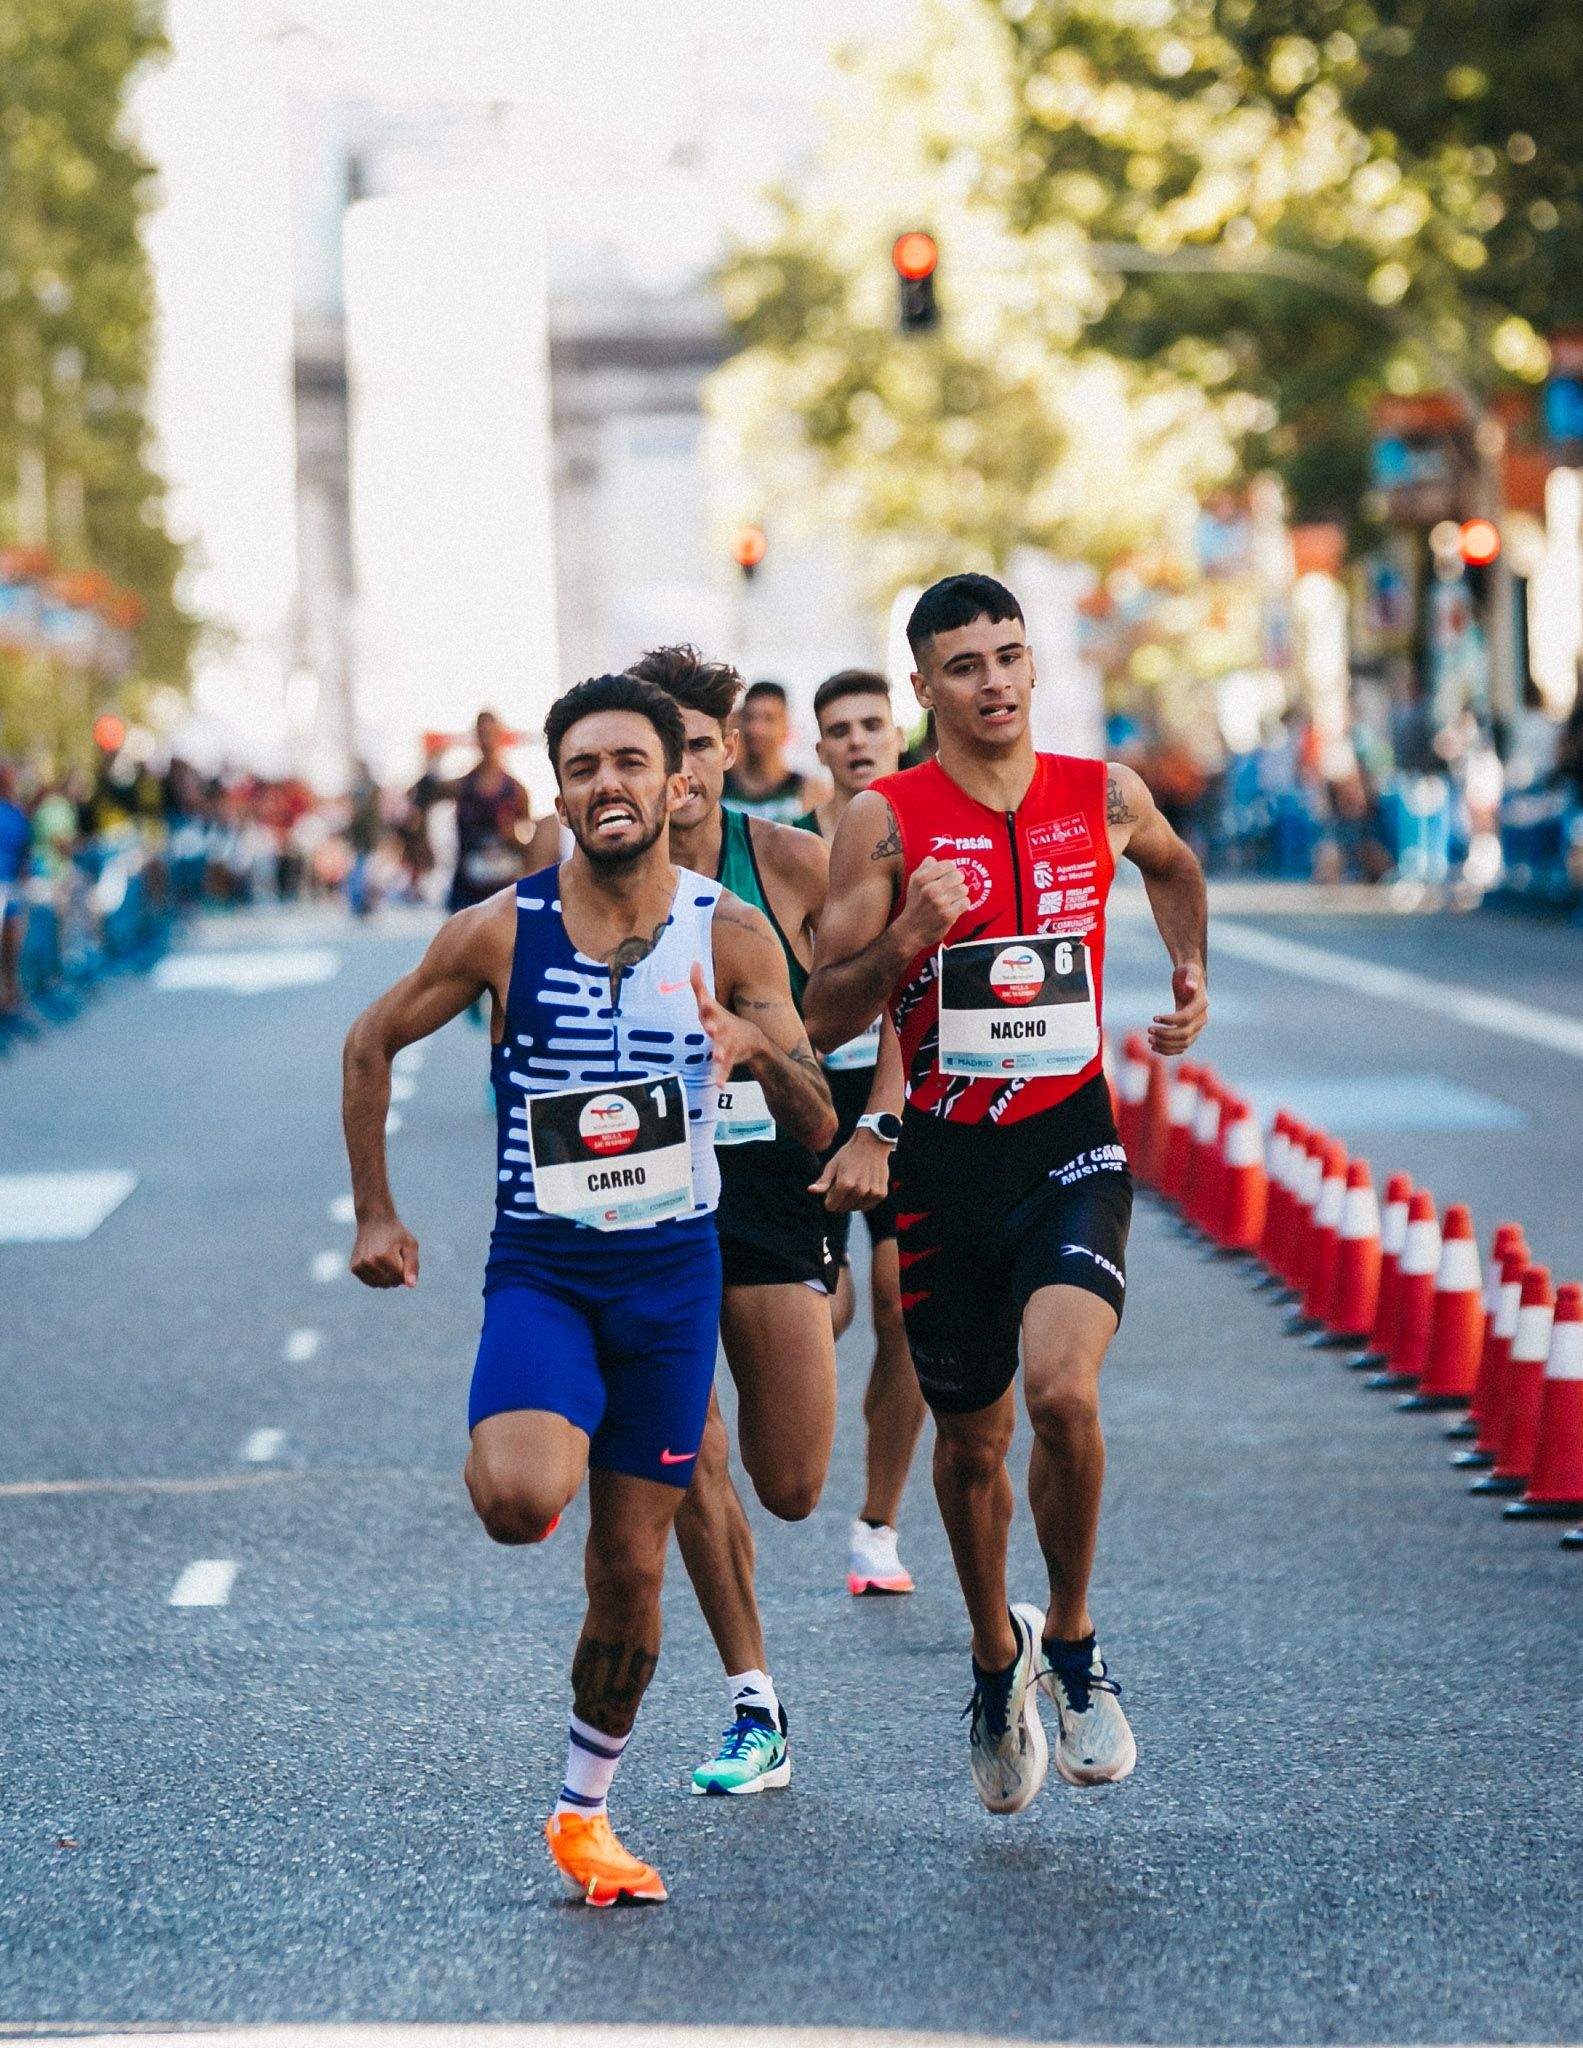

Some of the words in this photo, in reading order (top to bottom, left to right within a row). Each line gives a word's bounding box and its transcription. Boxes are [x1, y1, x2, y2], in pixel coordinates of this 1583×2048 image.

[955, 834, 993, 850] rasán
[1054, 941, 1073, 975] 6
[990, 1019, 1047, 1040] NACHO
[957, 1058, 993, 1068] MADRID
[650, 1085, 667, 1118] 1
[587, 1167, 646, 1192] CARRO
